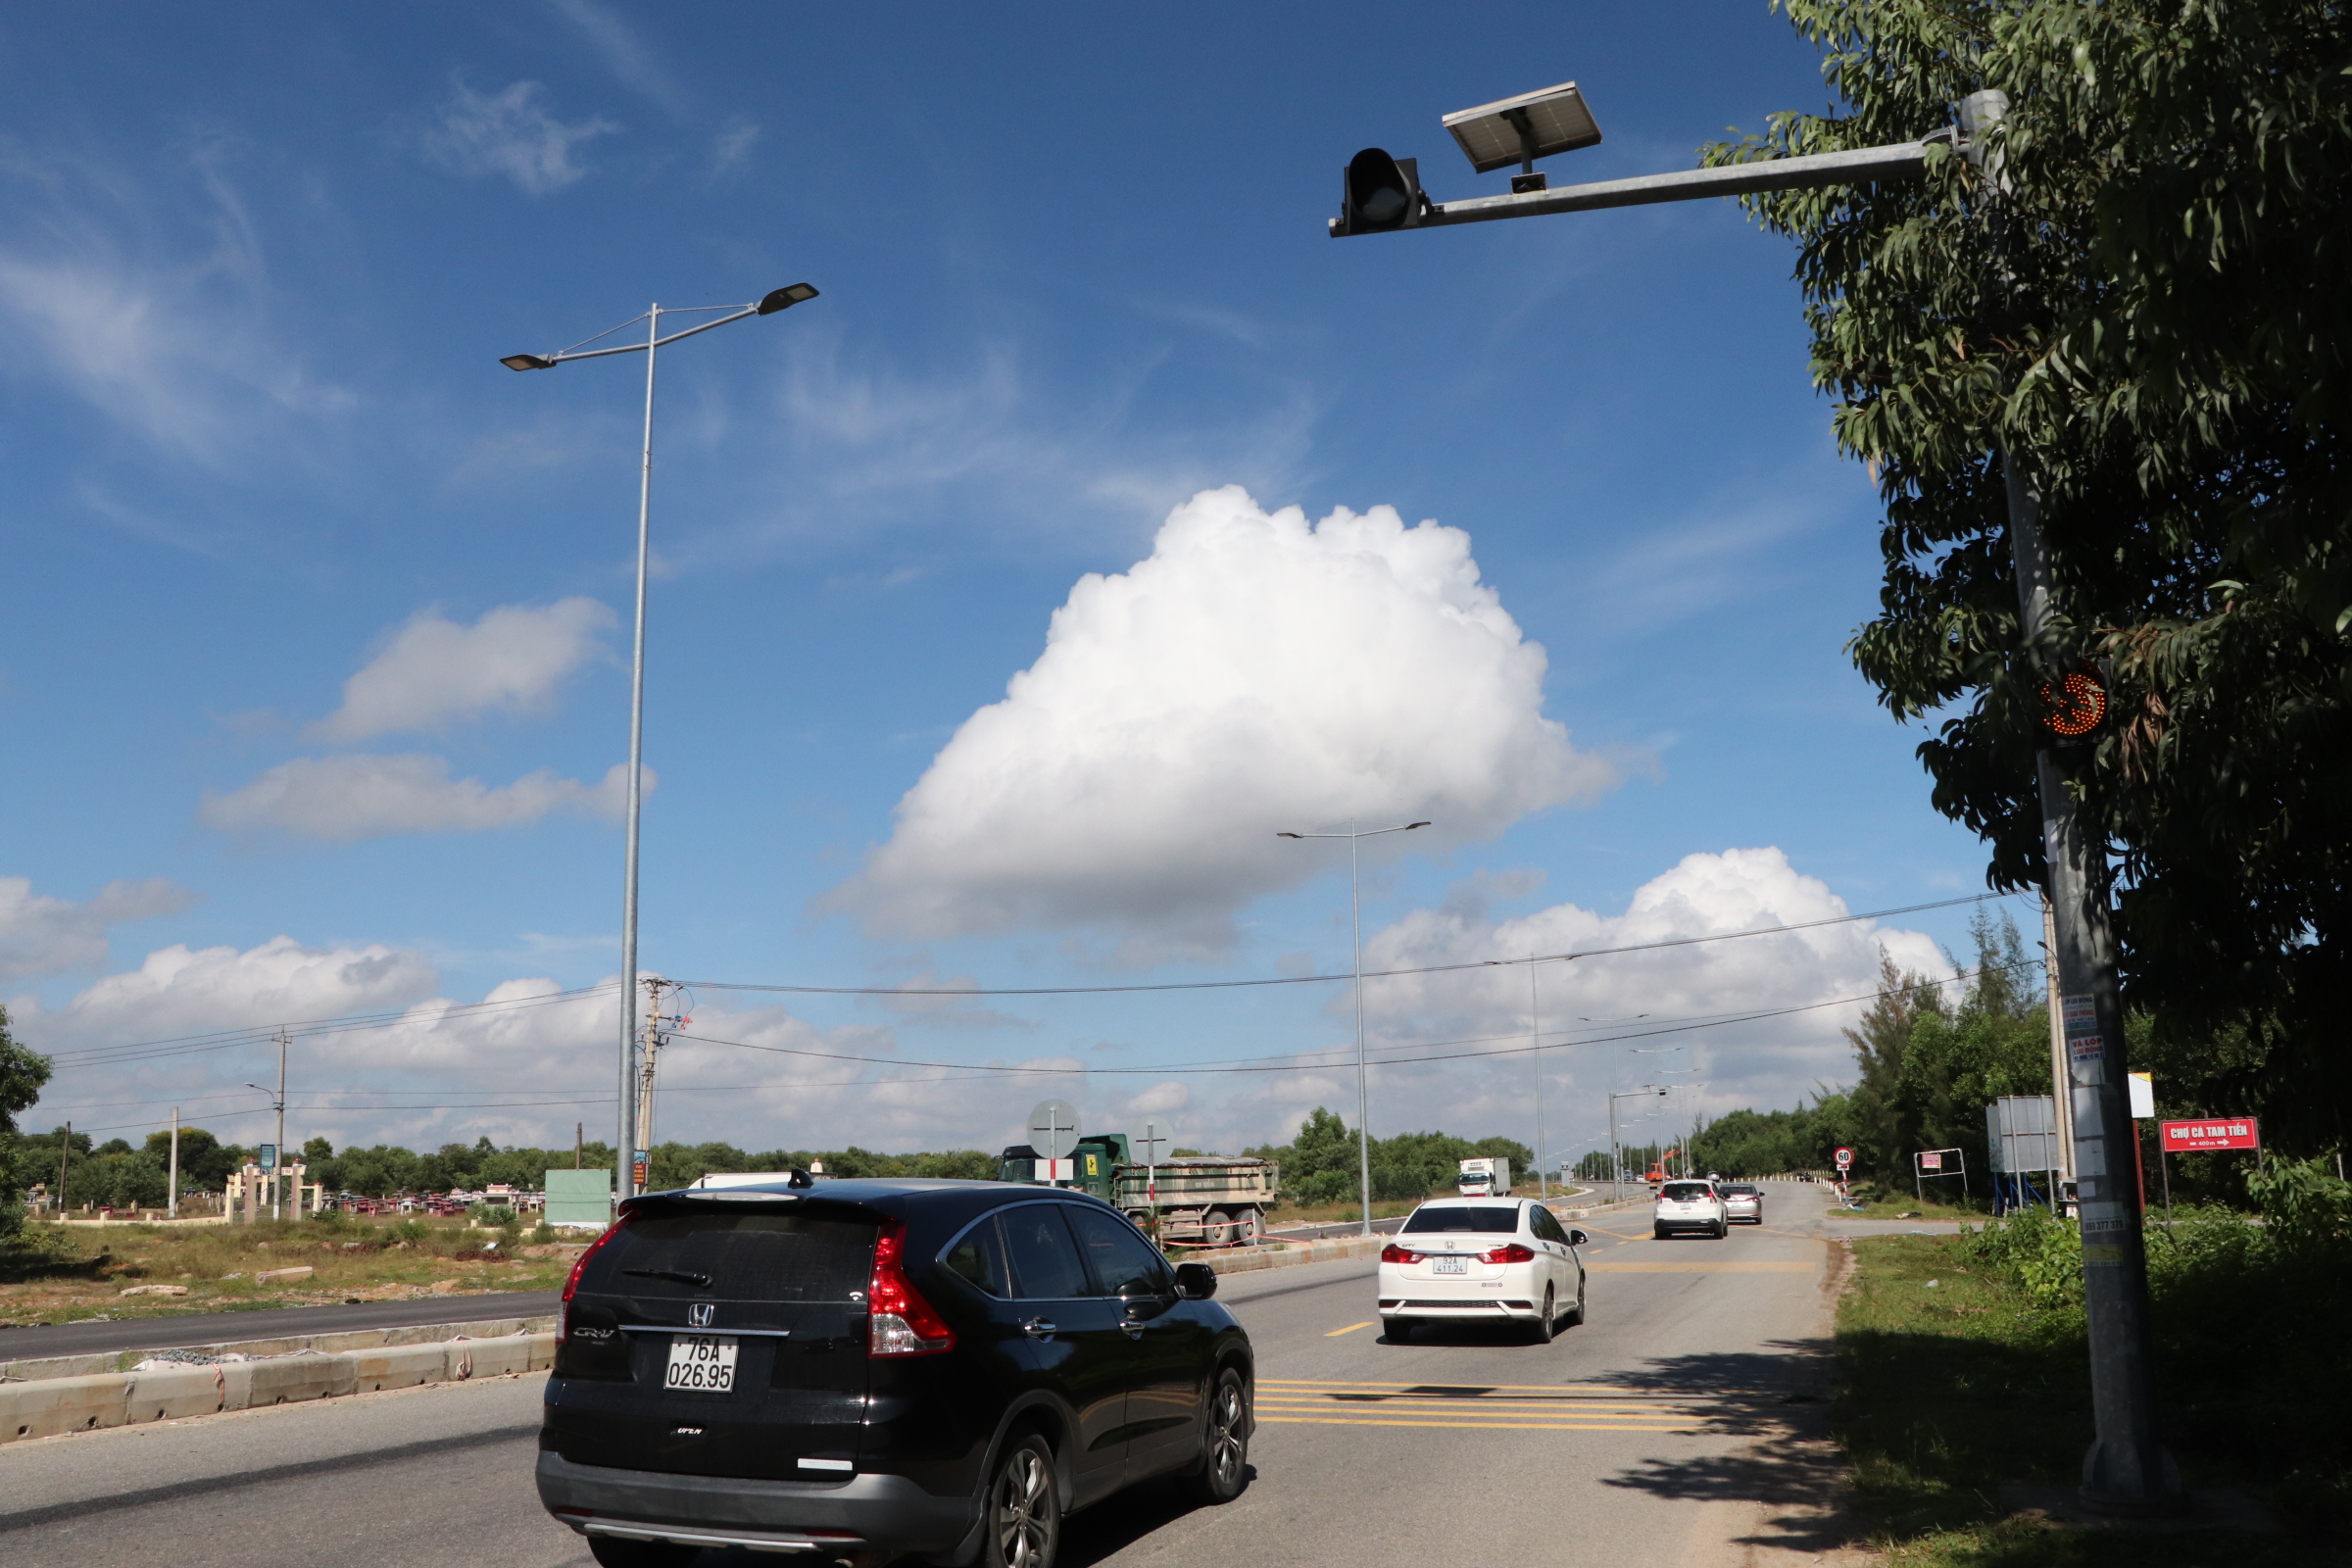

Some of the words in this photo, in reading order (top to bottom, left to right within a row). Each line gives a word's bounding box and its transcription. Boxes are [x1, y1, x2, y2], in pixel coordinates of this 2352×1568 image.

[2170, 1126, 2189, 1140] CHỢ
[2191, 1125, 2205, 1138] CÁ
[2206, 1126, 2227, 1137] TAM
[1838, 1152, 1849, 1161] 60
[1437, 1264, 1464, 1273] 411.24
[688, 1337, 720, 1362] 76A
[668, 1362, 732, 1389] 026.95
